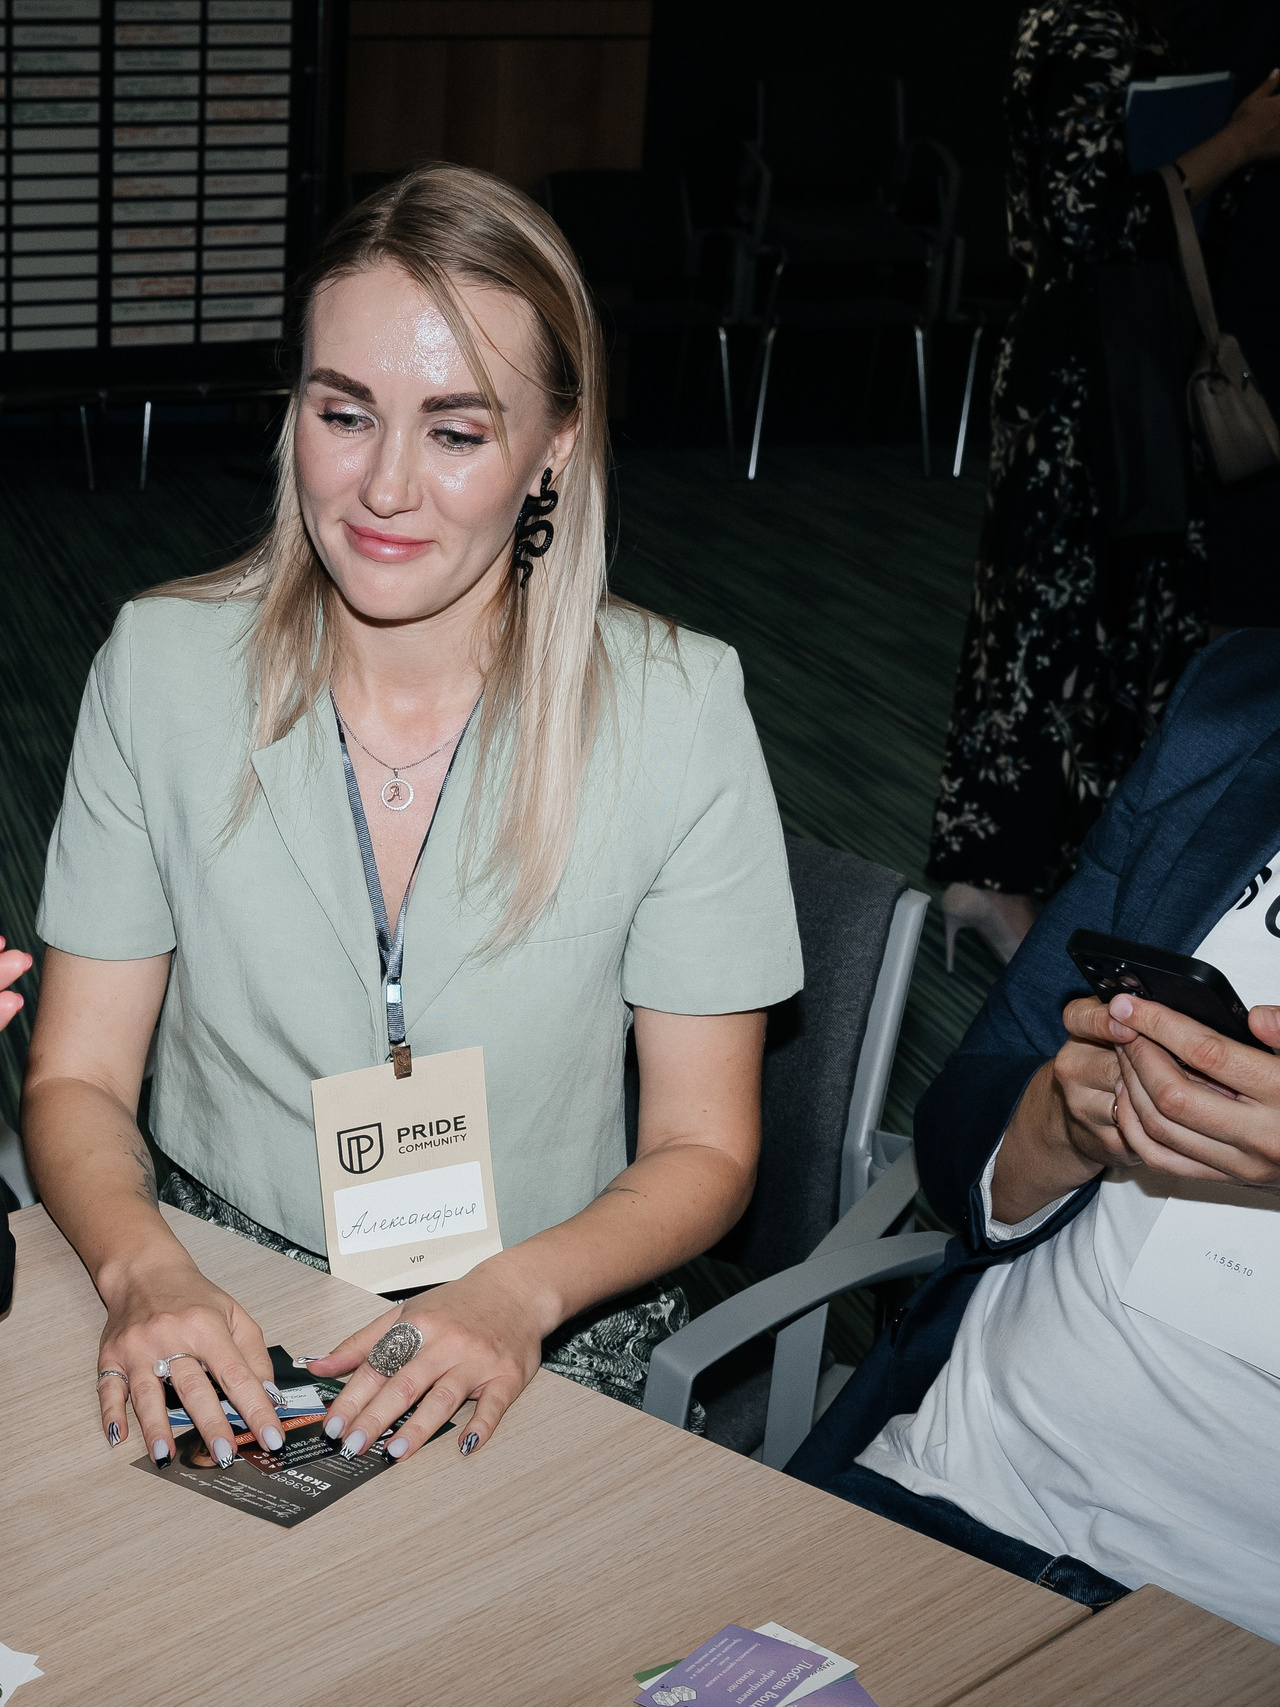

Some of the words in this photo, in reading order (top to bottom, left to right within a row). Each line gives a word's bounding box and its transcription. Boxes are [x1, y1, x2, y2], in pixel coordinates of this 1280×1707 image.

[396, 1114, 467, 1144] PRIDE
[398, 1133, 468, 1154] COMMUNITY
[341, 1202, 477, 1239] Александрия
[409, 1254, 425, 1264] VIP
[283, 1469, 332, 1491] Екате
[726, 1668, 756, 1693] психолог
[735, 1669, 777, 1704] игротерапевт
[771, 1659, 814, 1691] Любовь
